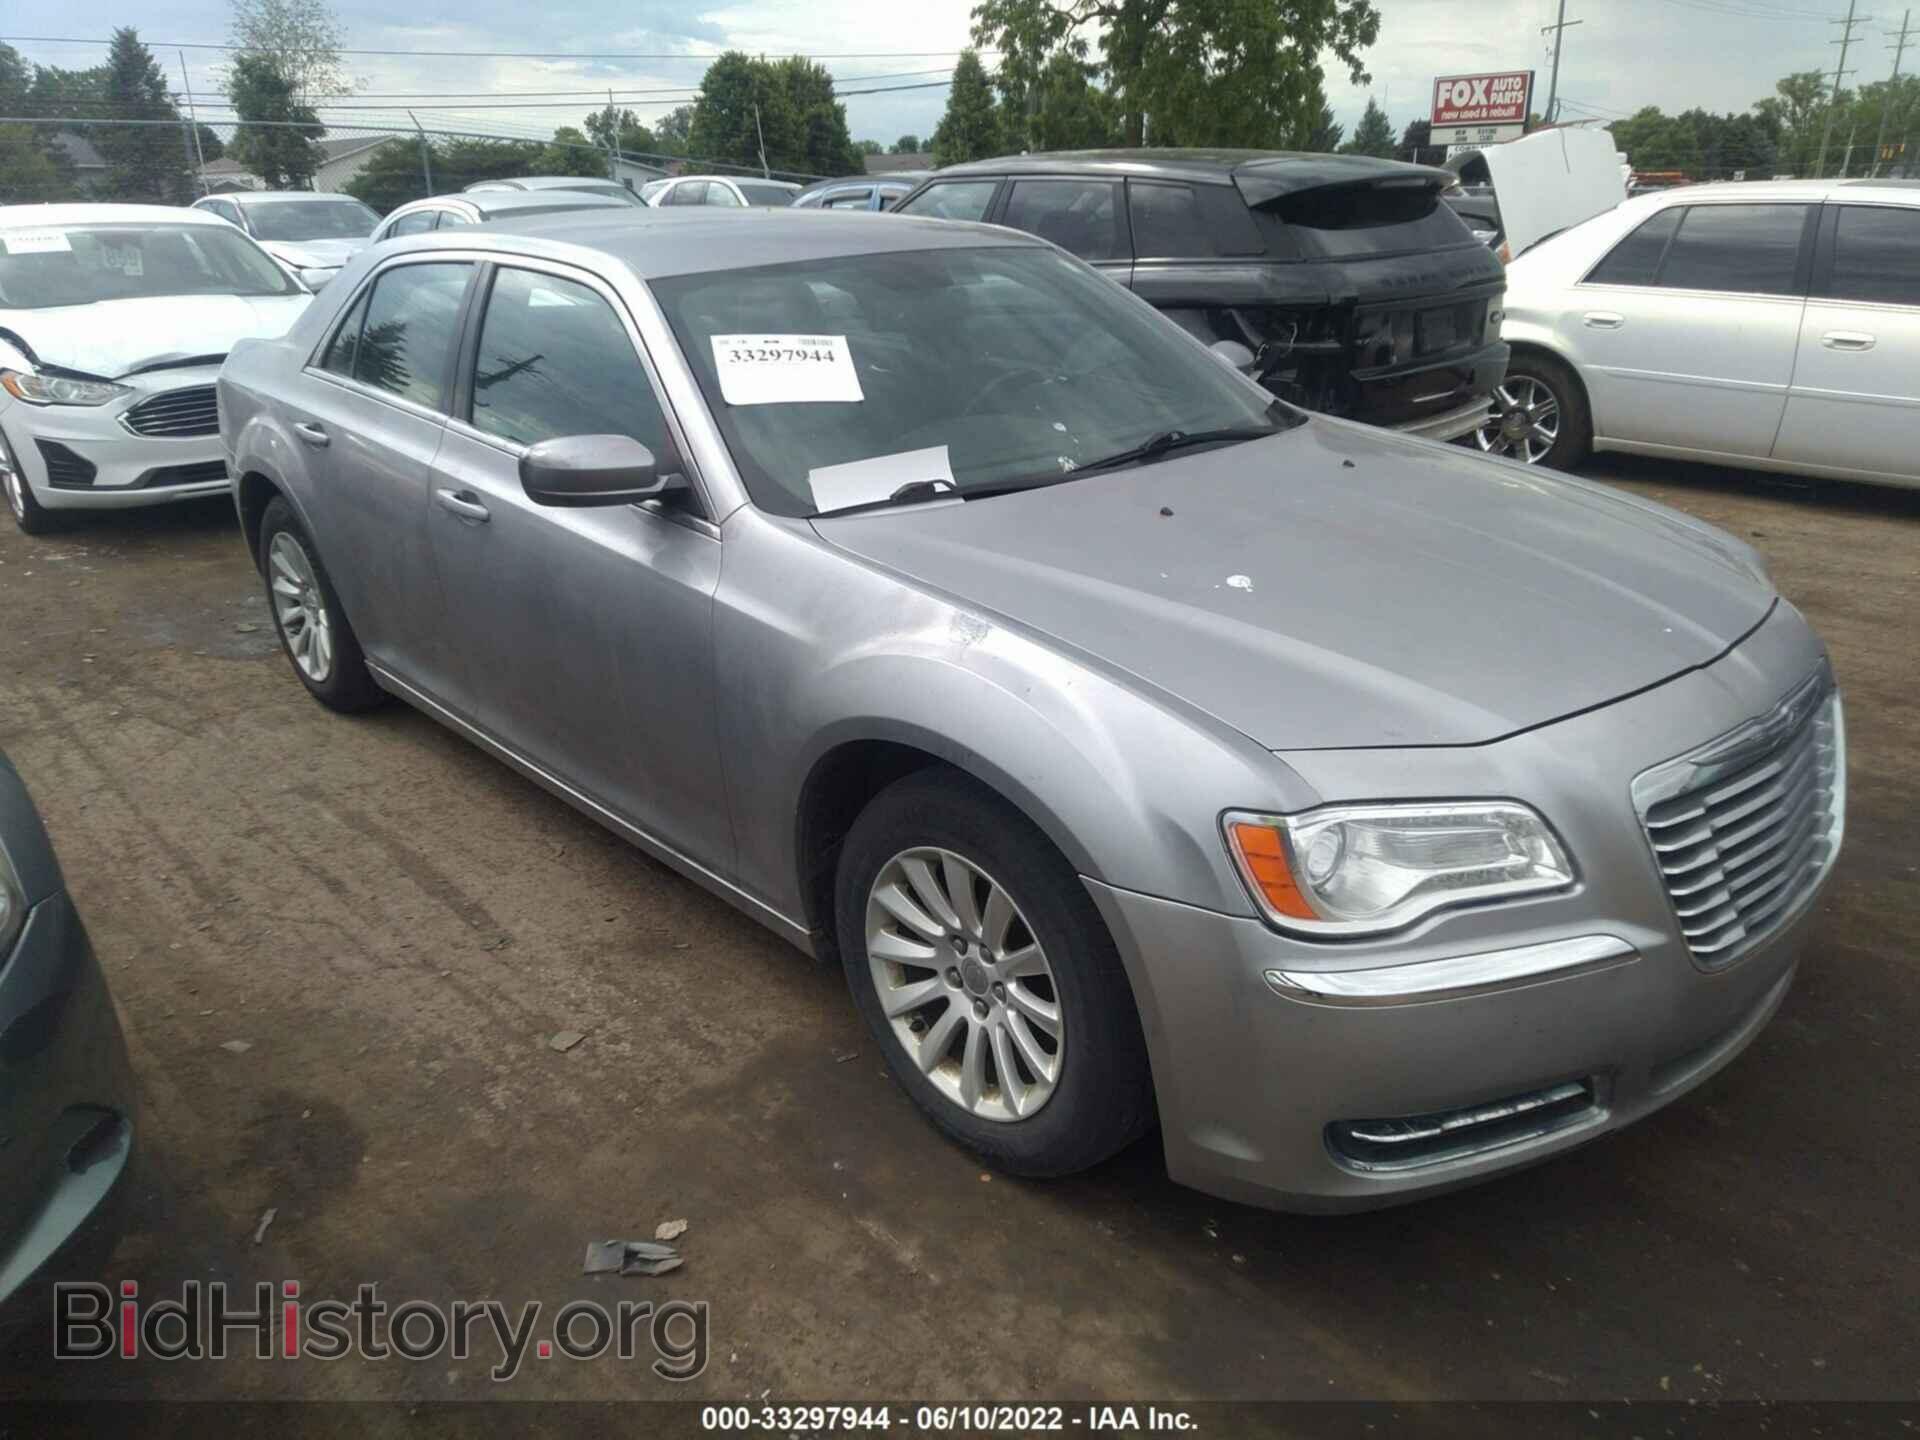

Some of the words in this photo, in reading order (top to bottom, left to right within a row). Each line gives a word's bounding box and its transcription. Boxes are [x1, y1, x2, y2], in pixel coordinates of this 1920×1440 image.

[1492, 77, 1522, 91] AUTO
[1437, 79, 1490, 109] FOX
[1490, 90, 1524, 105] PARTS
[1441, 110, 1459, 121] new
[1459, 107, 1481, 120] used
[1489, 106, 1516, 118] rebuilt
[729, 348, 836, 363] 33297944
